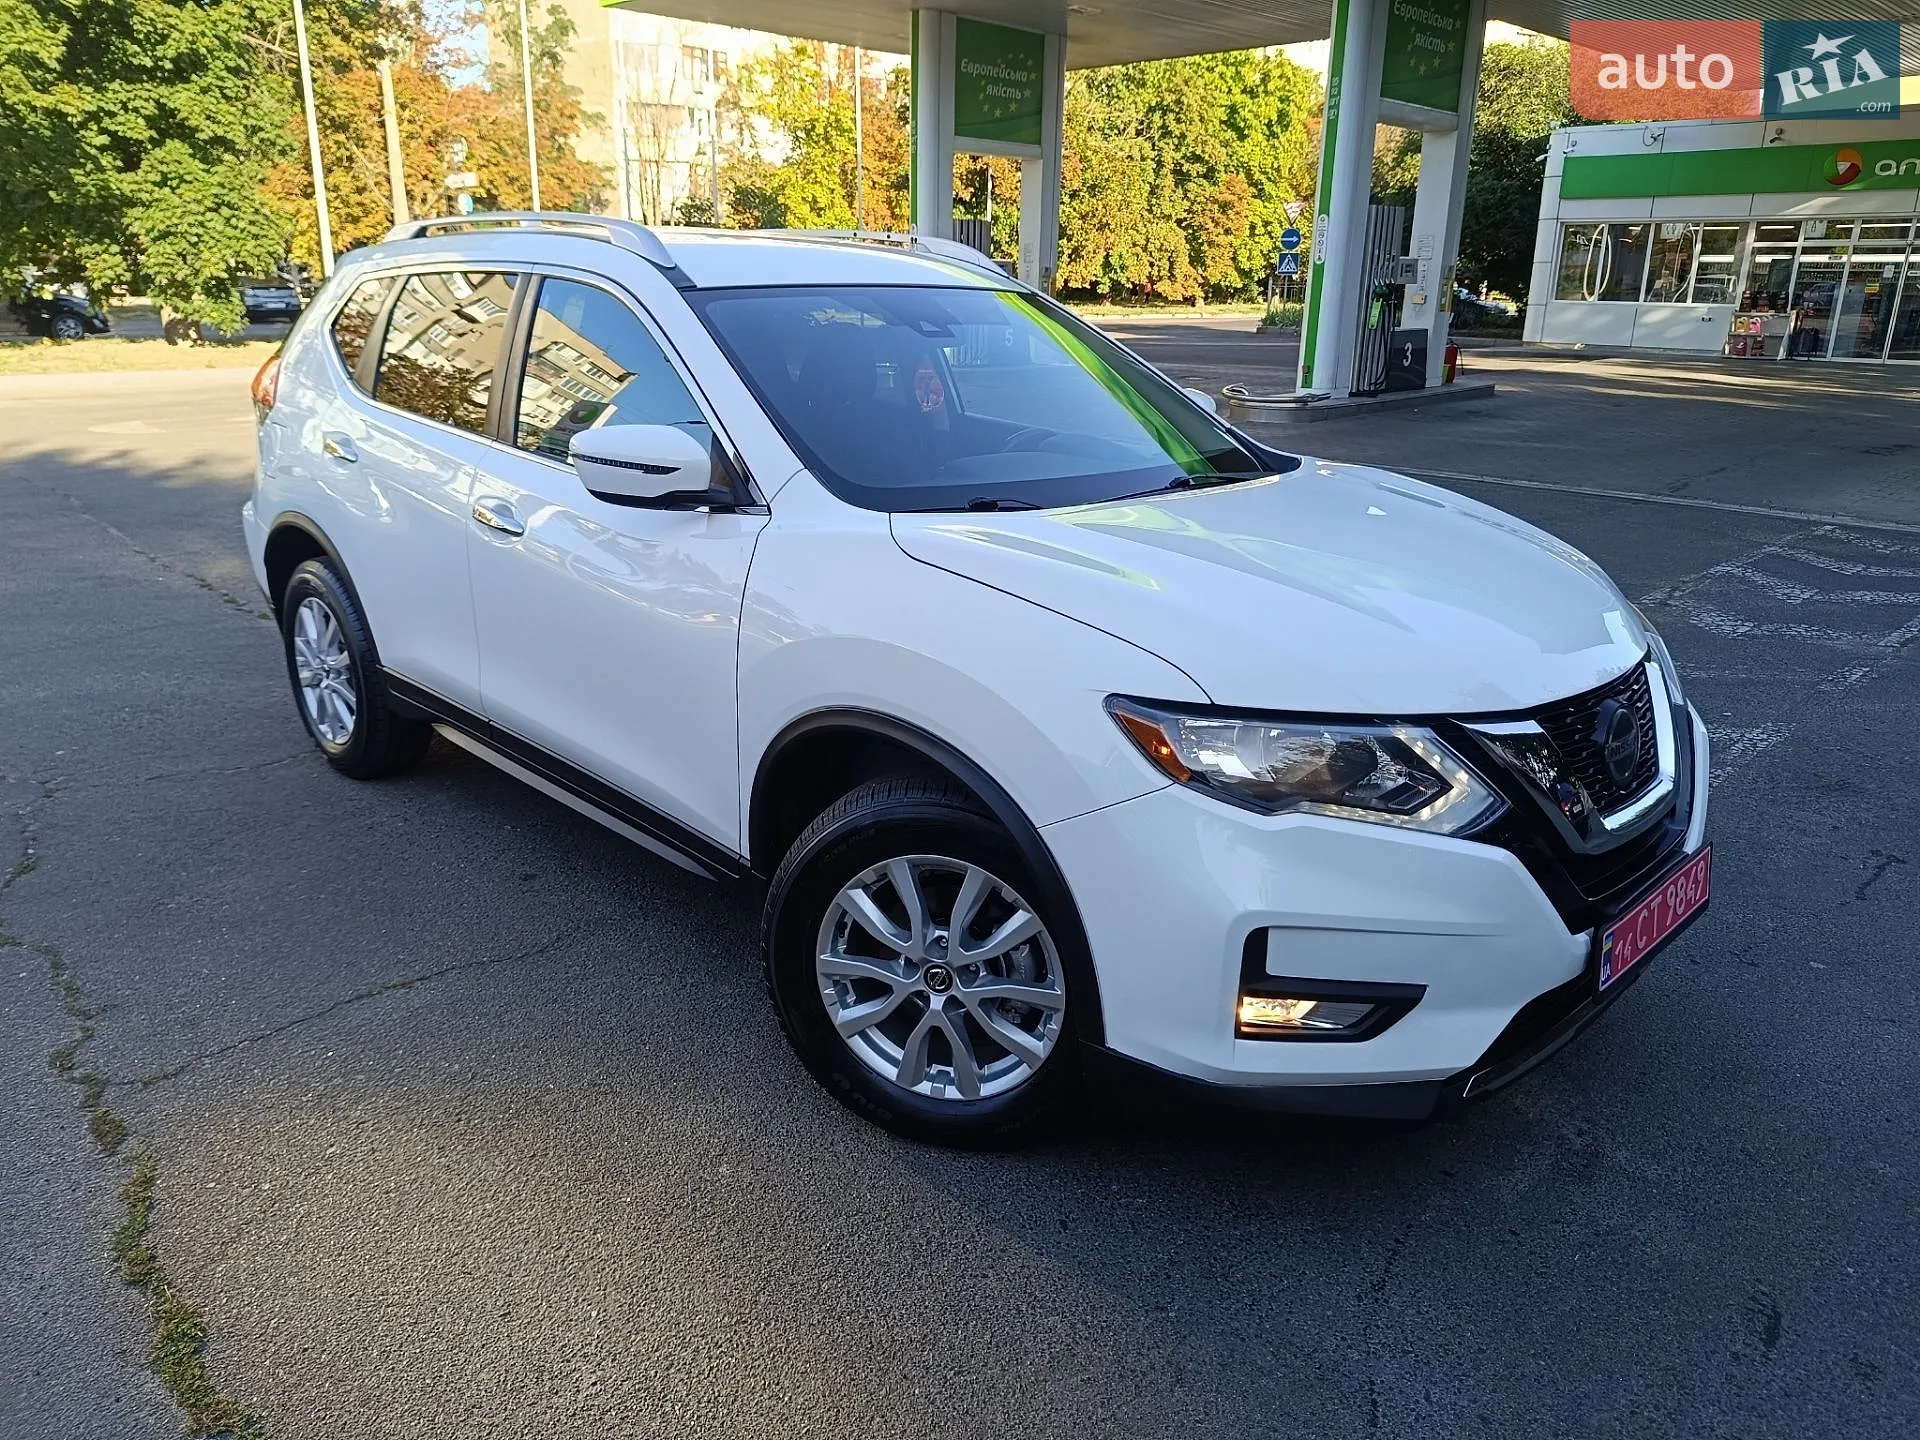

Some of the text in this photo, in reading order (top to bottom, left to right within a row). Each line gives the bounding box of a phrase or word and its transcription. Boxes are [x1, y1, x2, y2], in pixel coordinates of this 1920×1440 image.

[1393, 0, 1454, 30] Європейська
[1414, 32, 1446, 53] якість
[960, 58, 1028, 82] Європейська
[986, 83, 1022, 100] якість
[1403, 342, 1413, 367] 3
[1636, 895, 1663, 949] CT
[1666, 860, 1705, 926] 9849
[1601, 964, 1611, 981] UA
